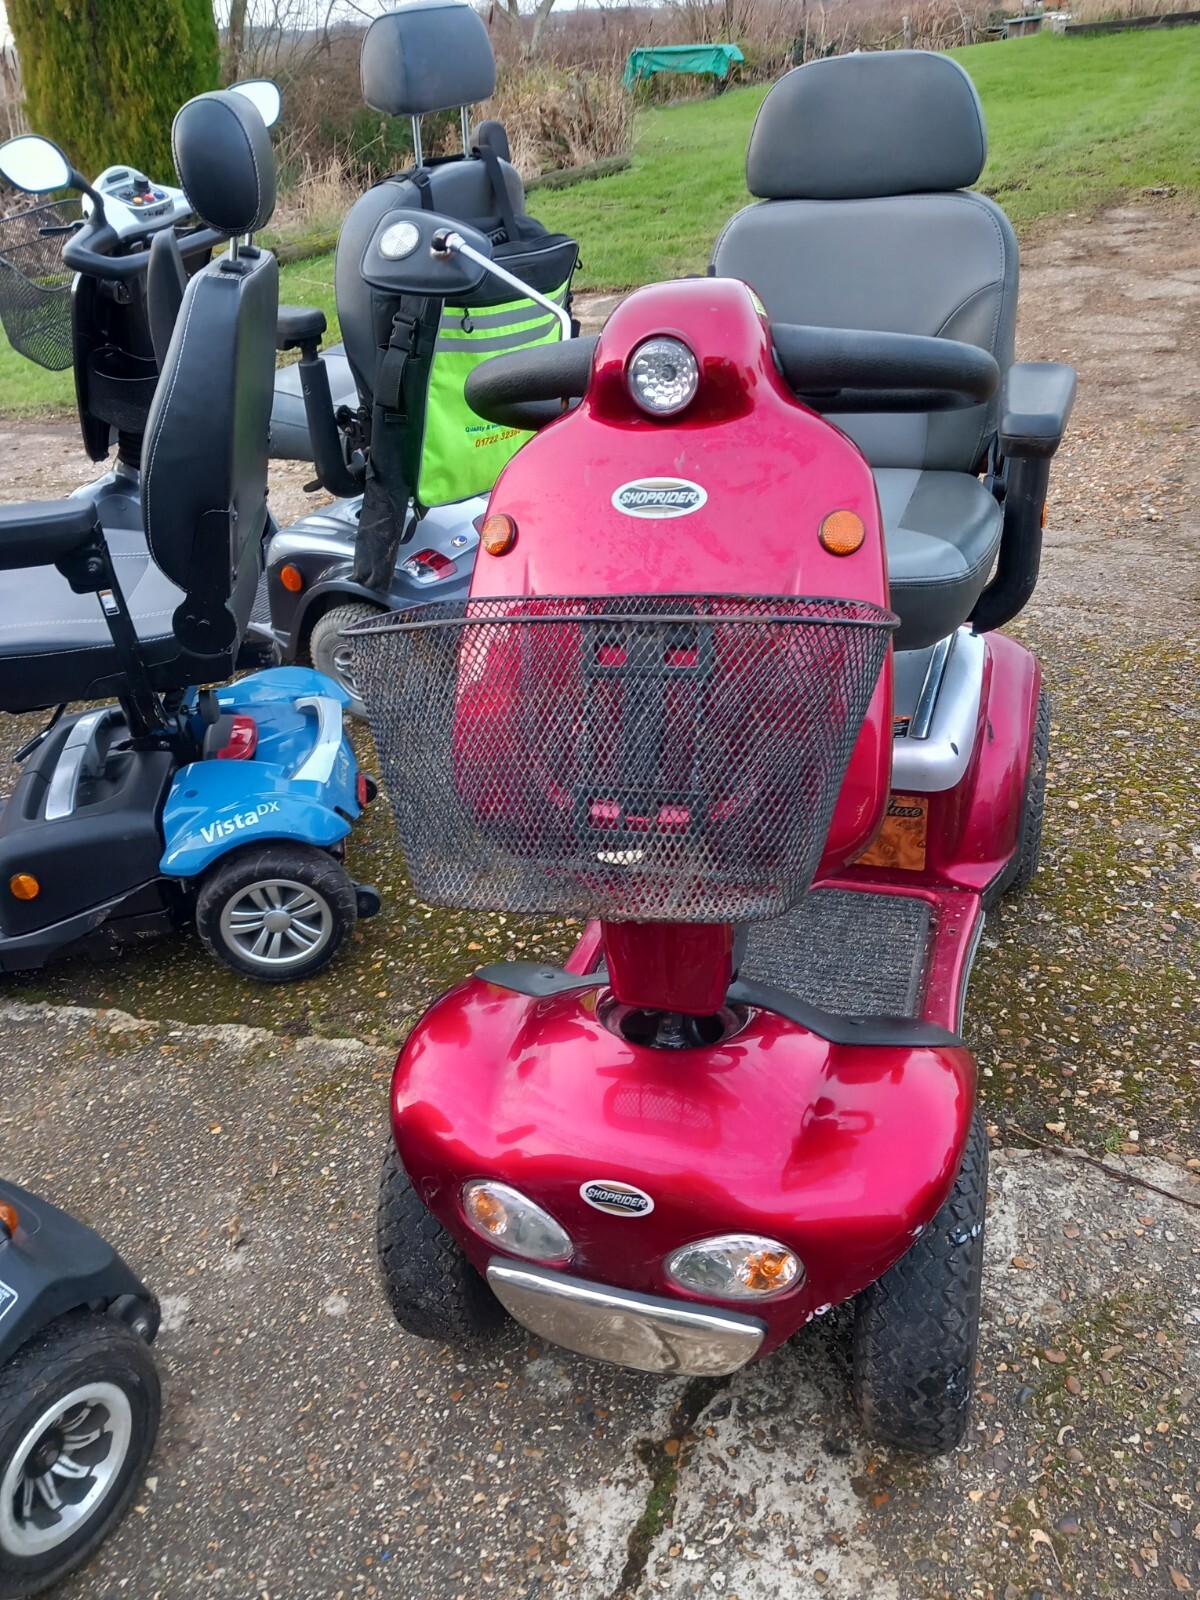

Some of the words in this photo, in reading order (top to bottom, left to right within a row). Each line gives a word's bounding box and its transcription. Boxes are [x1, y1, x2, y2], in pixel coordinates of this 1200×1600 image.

[465, 425, 485, 433] Quality
[475, 434, 498, 448] 01722
[620, 491, 699, 504] SHOPRIDER
[887, 800, 921, 816] luxe
[586, 1188, 647, 1209] SHOPRIDER
